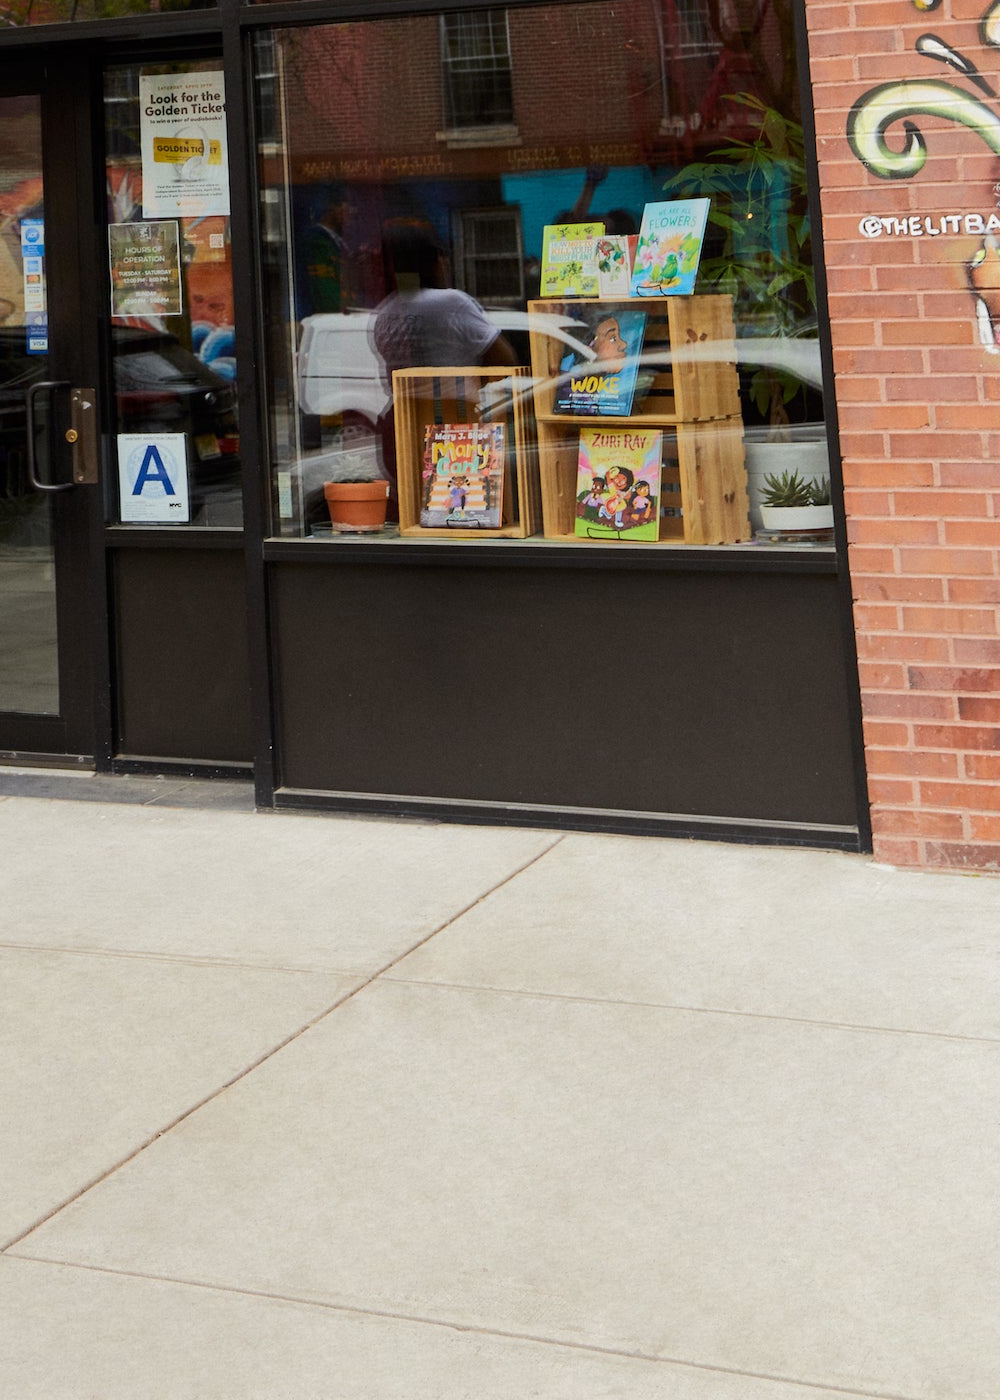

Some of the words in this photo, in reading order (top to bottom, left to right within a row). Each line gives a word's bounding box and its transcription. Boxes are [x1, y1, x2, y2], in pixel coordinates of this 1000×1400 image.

[150, 93, 178, 105] Look
[181, 92, 198, 103] for
[201, 91, 221, 101] the
[145, 105, 188, 116] Golden
[191, 102, 227, 114] Ticket
[157, 145, 189, 153] GOLDEN
[191, 146, 217, 154] TICET
[658, 207, 667, 216] WE
[649, 215, 698, 230] FLOWERS
[123, 255, 166, 264] OPERATION
[571, 375, 620, 394] WOKE
[434, 433, 456, 441] Mary
[458, 432, 467, 440] J.
[467, 431, 489, 440] Blige
[624, 433, 647, 451] RAY
[432, 442, 490, 470] Mary
[132, 445, 176, 496] A
